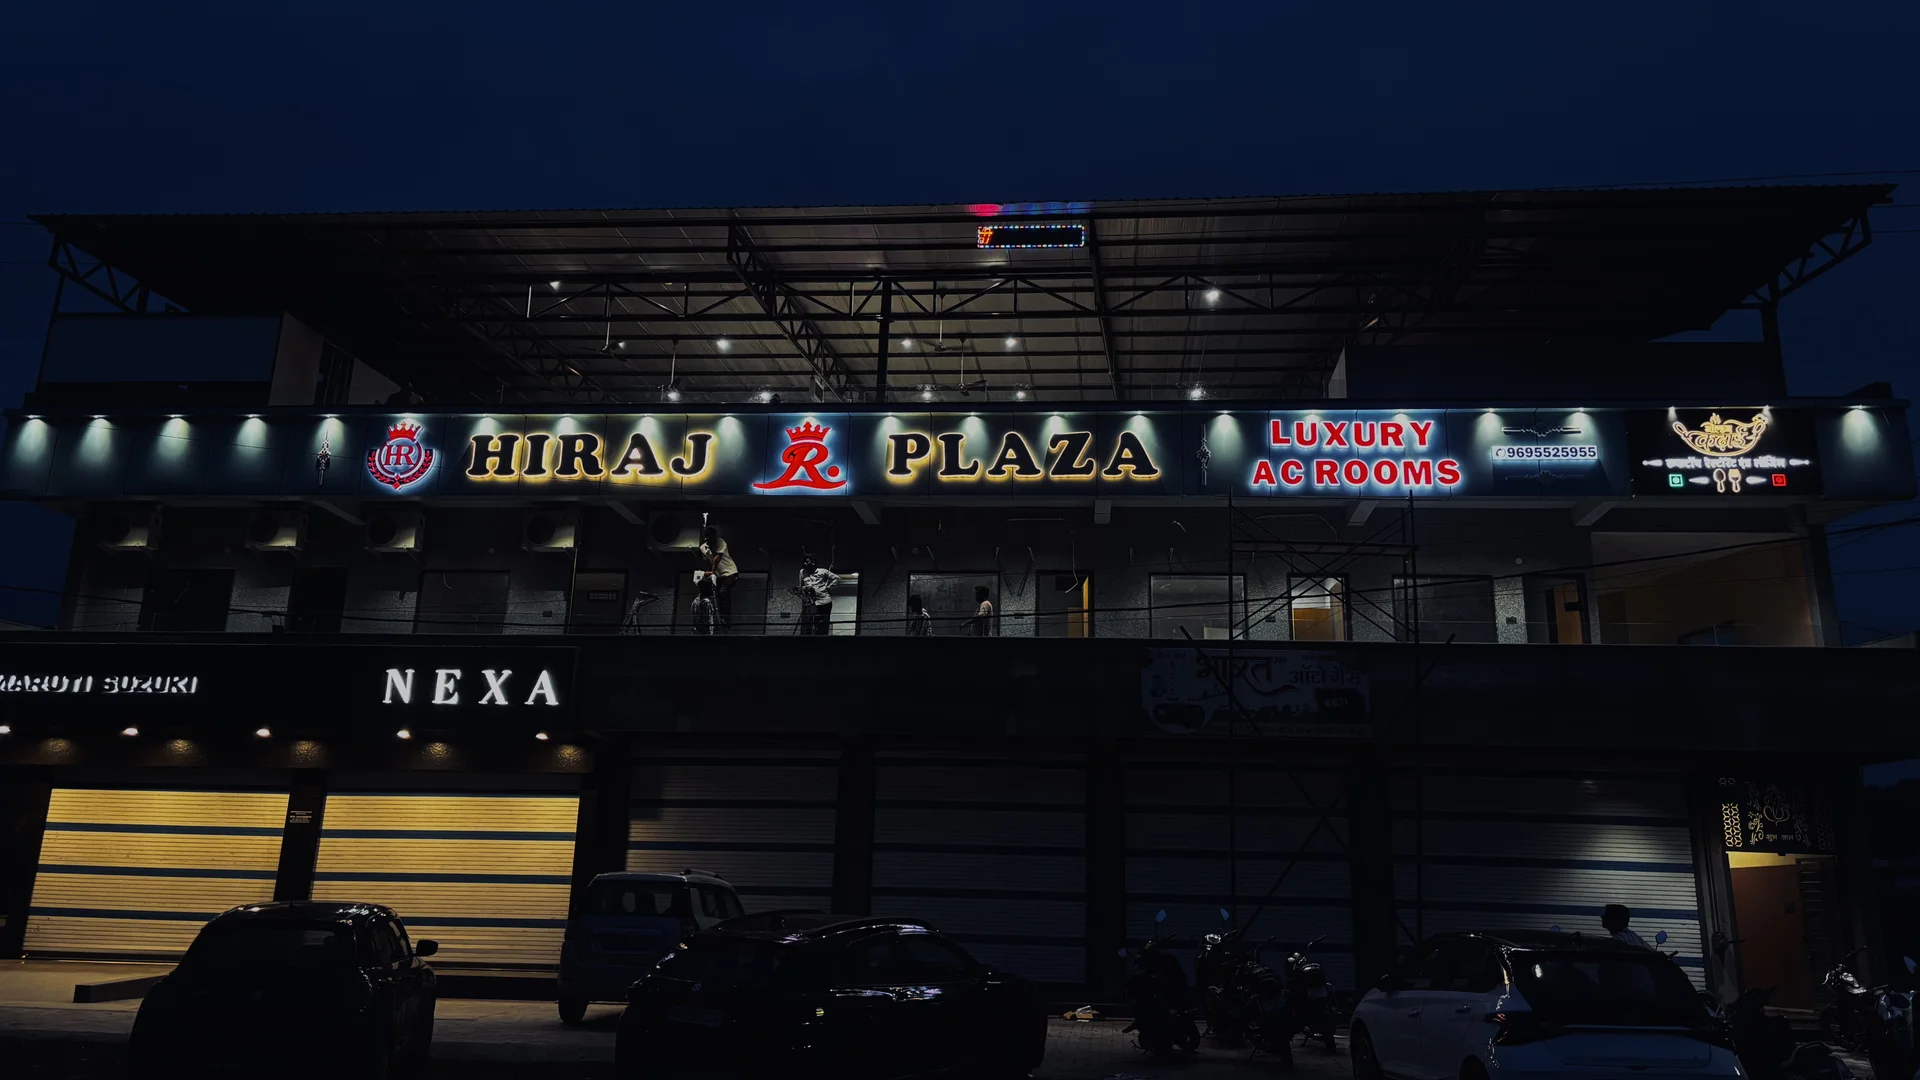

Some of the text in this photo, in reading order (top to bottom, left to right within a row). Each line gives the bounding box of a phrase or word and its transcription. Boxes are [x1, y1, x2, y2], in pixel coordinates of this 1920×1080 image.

[1270, 419, 1435, 448] LUXURY
[384, 444, 415, 466] HR
[465, 432, 1161, 480] HIRAJ PLAZA
[1506, 446, 1597, 459] 9695525955
[1251, 459, 1463, 488] AC ROOMS
[101, 675, 199, 694] SUZUKI
[381, 667, 560, 707] NEXA
